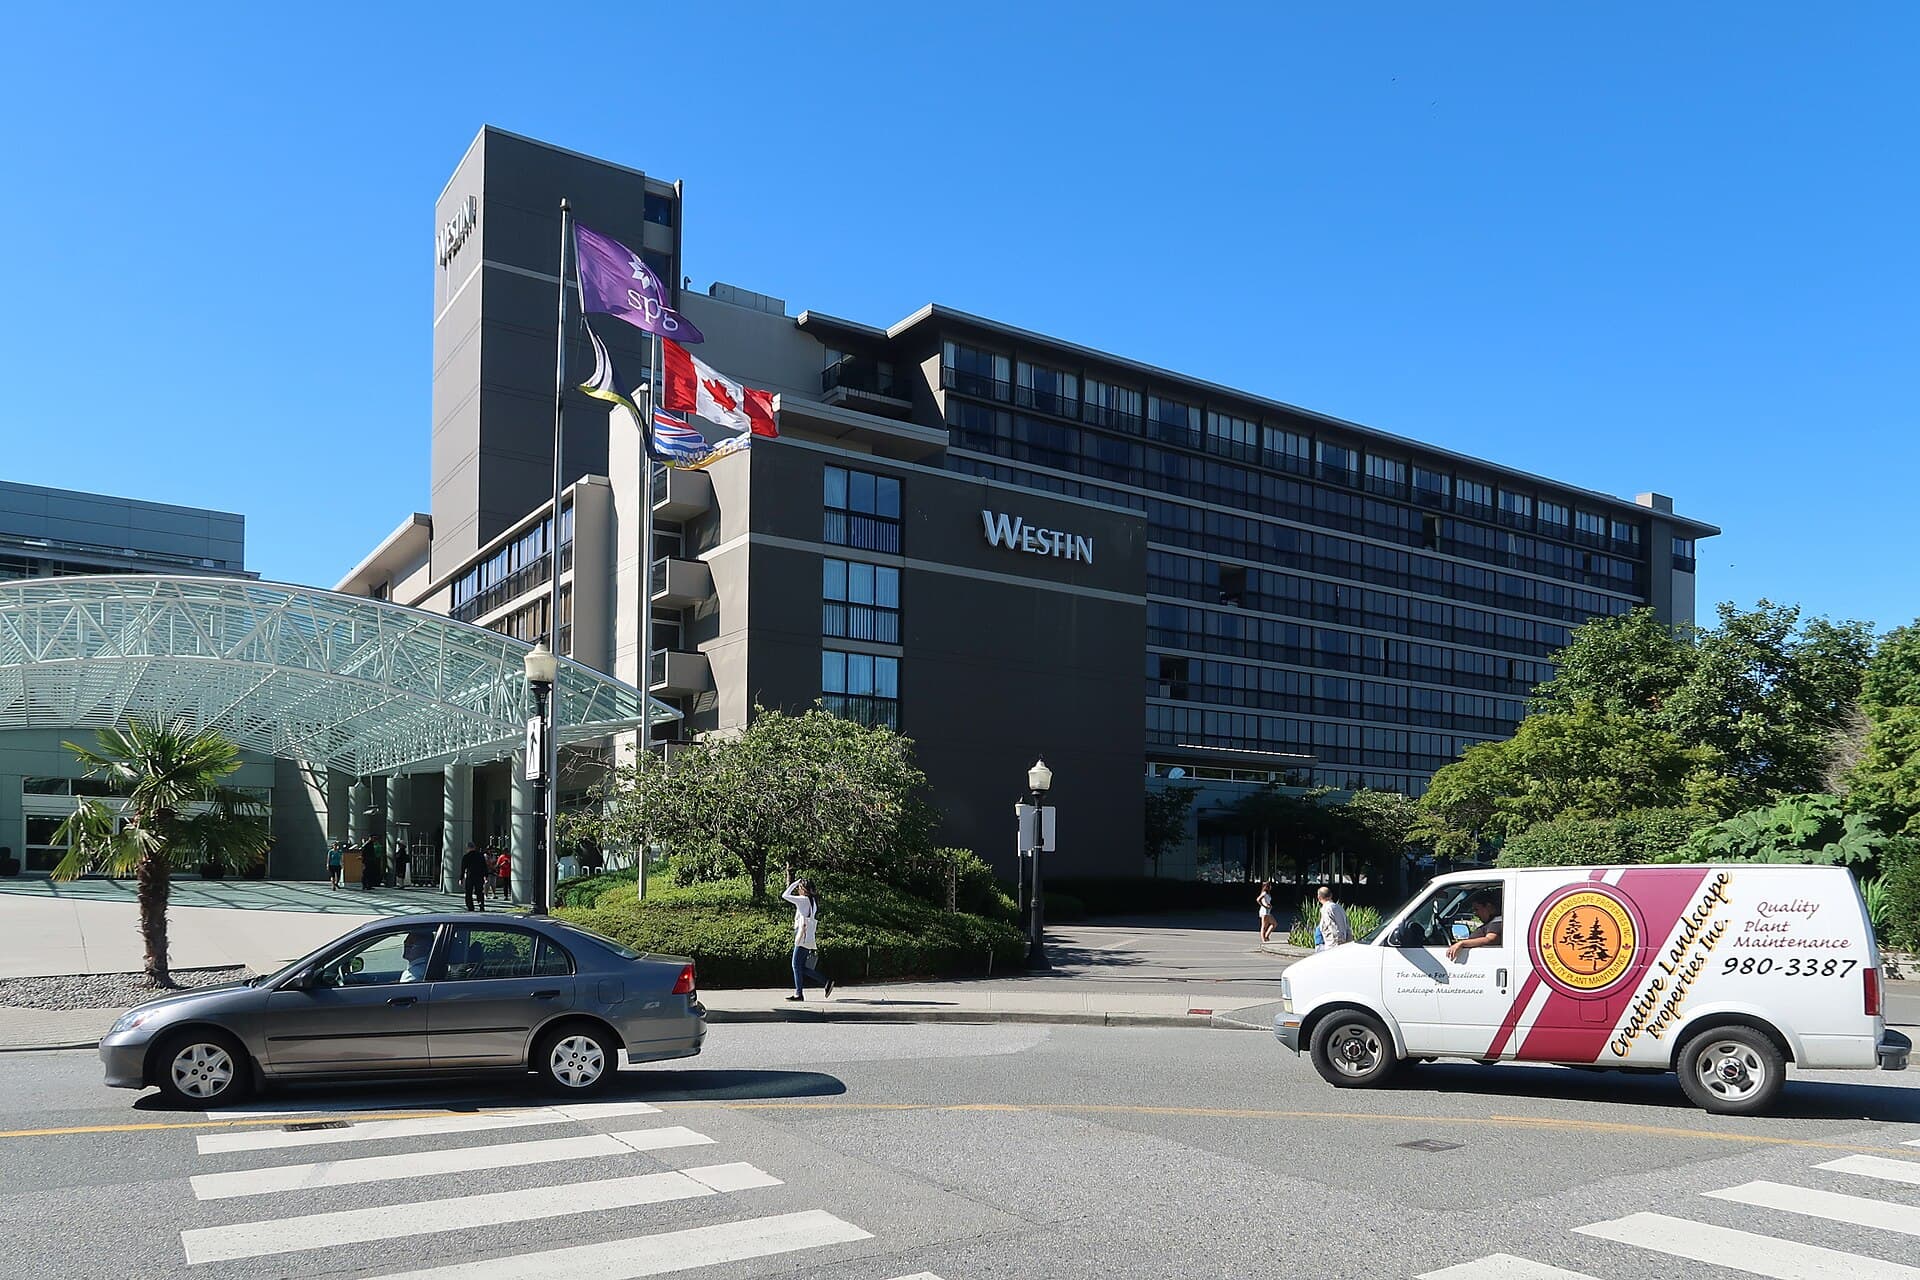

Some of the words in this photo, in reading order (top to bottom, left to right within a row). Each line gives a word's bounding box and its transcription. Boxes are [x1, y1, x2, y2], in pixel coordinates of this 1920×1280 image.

[436, 194, 476, 269] WESTIN
[982, 509, 1093, 565] WESTIN
[1543, 912, 1559, 940] CREATIVE
[1558, 896, 1594, 914] LANDSCAPE
[1596, 897, 1628, 927] PROPERTIES
[1756, 899, 1820, 920] Quality
[1744, 919, 1791, 932] Plant
[1733, 935, 1852, 948] Maintenance
[1448, 971, 1486, 979] Excellence
[1546, 953, 1567, 977] QUALITY
[1567, 974, 1588, 985] PLANT
[1588, 954, 1627, 985] MAINTENANCE
[1610, 976, 1666, 1058] Creative
[1658, 872, 1731, 976] Landscape
[1721, 957, 1858, 978] 980-3387
[1397, 987, 1434, 996] Landscape
[1436, 987, 1484, 995] Maintenance
[1645, 952, 1706, 1040] Properties
[1699, 919, 1730, 952] Inc.
